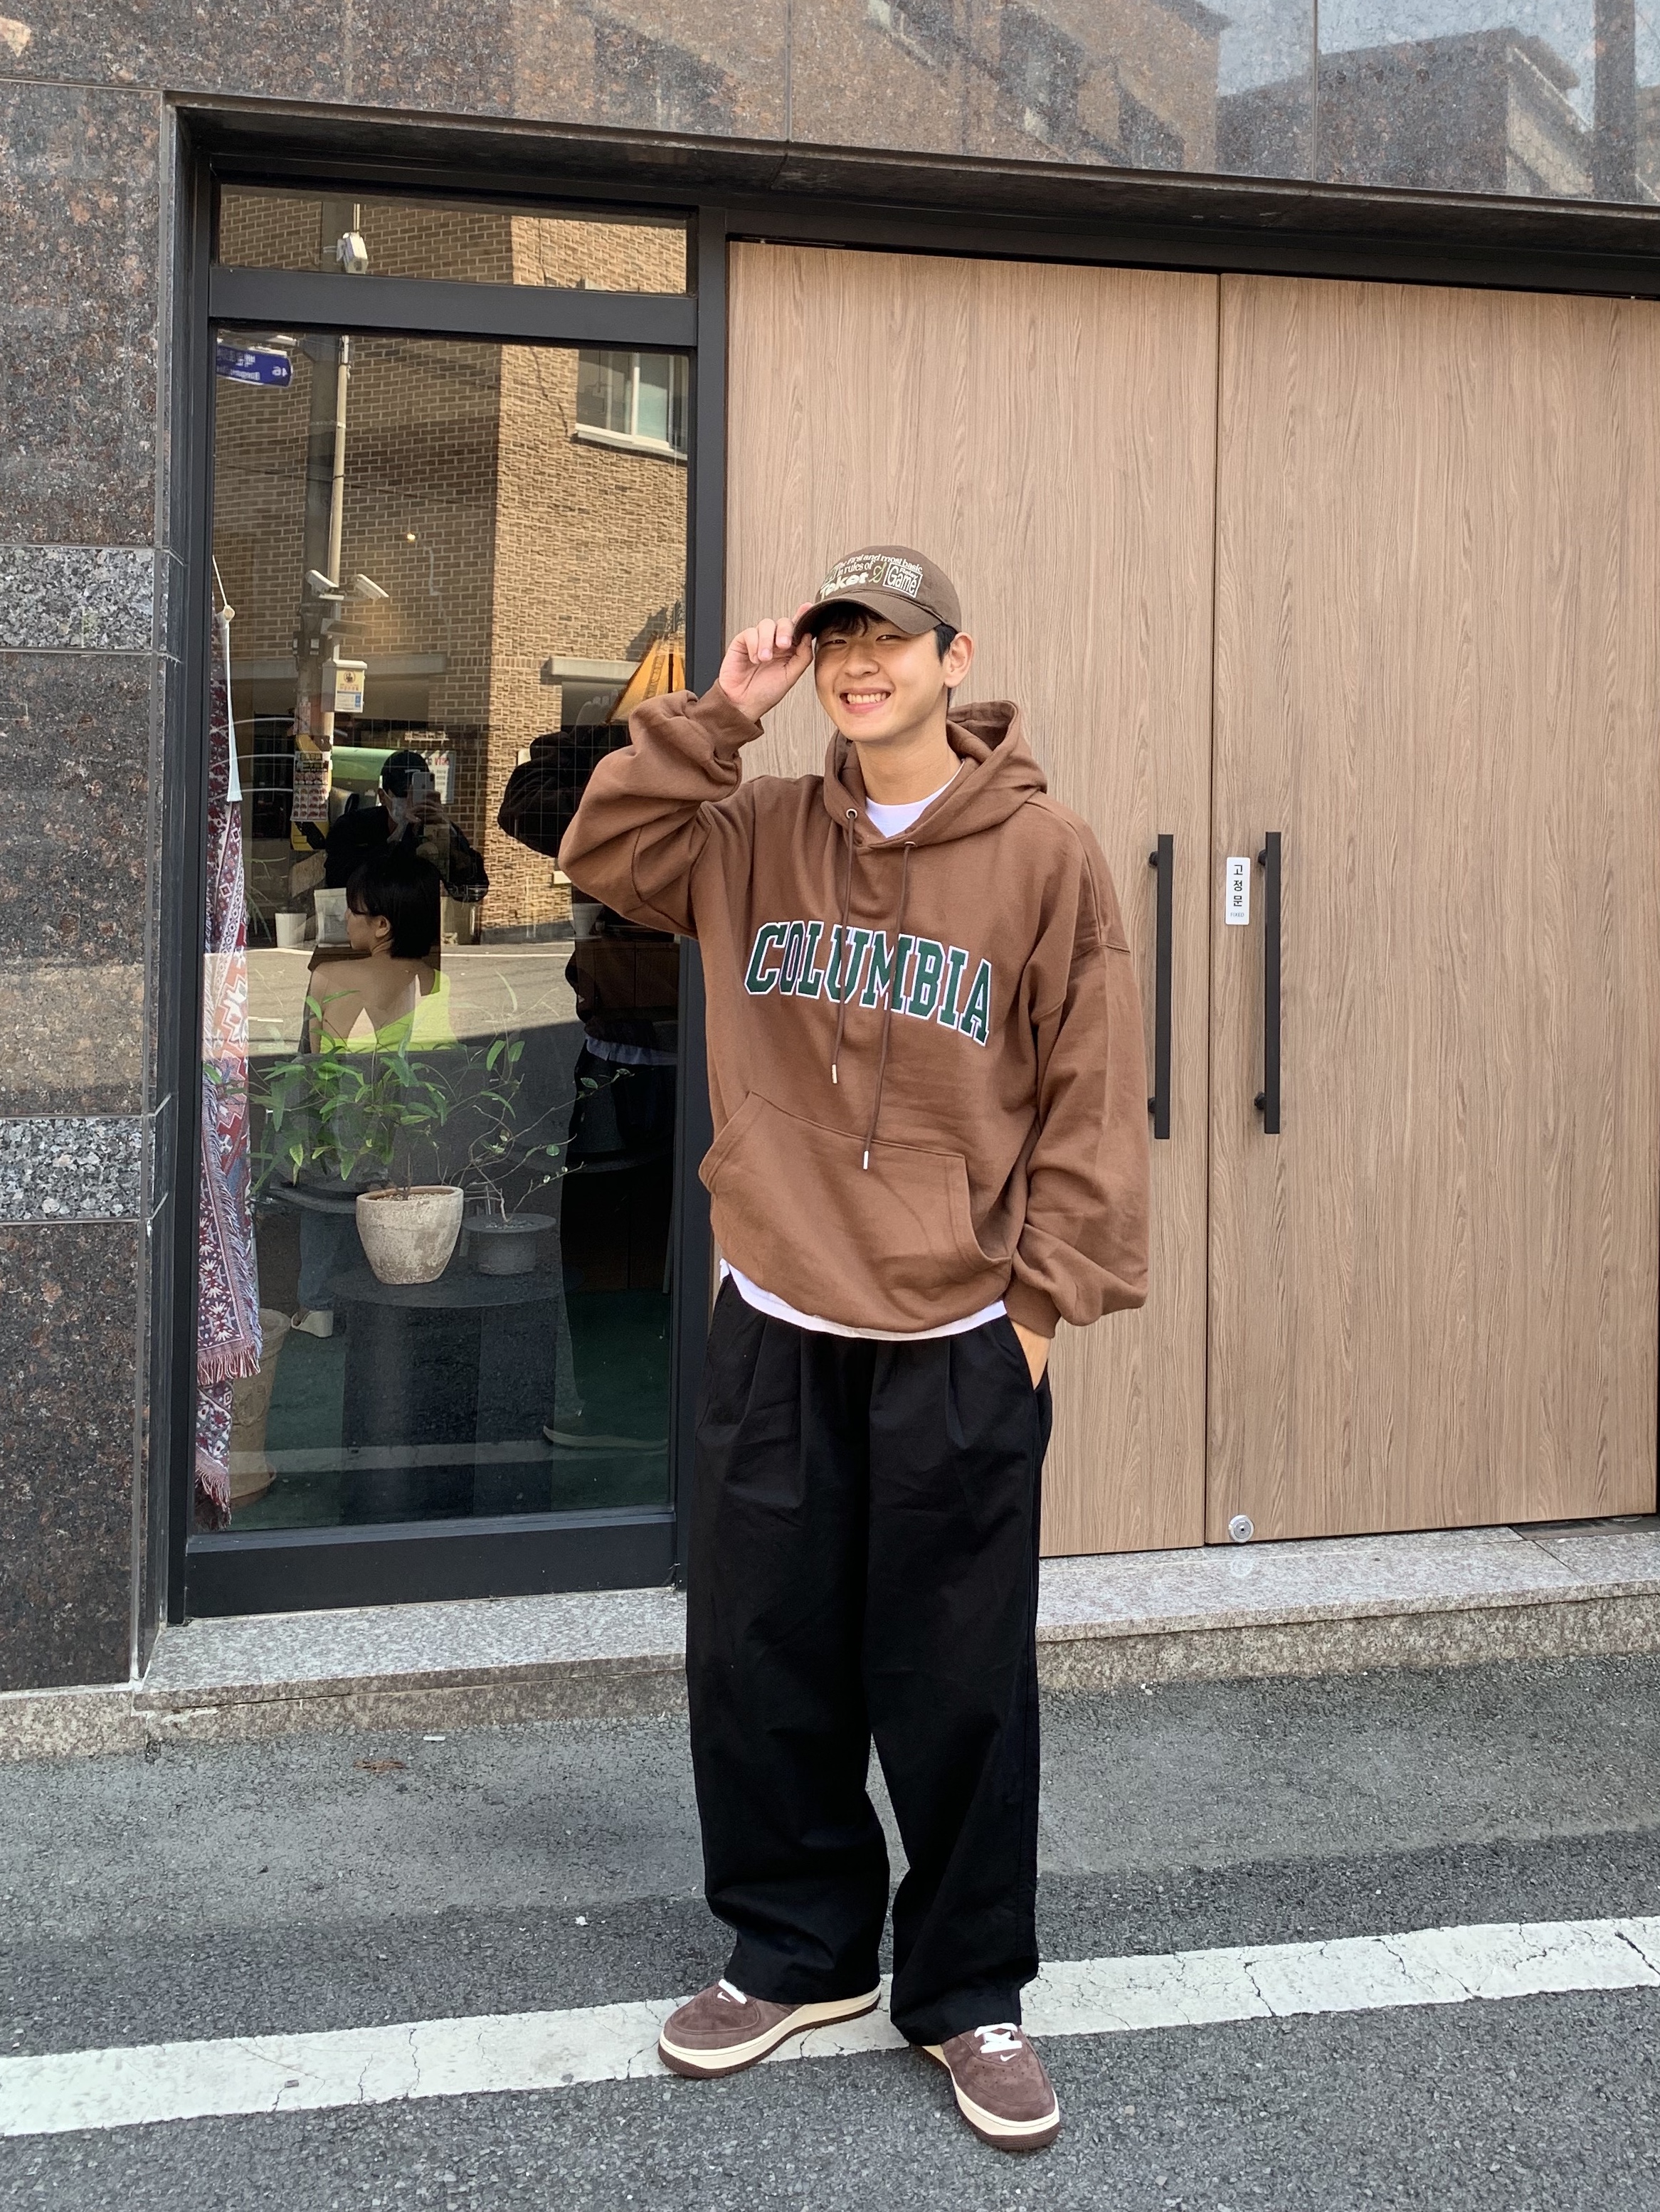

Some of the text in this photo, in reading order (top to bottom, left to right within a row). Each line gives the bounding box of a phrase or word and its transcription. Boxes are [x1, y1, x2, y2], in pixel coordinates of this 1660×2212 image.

[844, 562, 864, 573] rules
[864, 560, 876, 570] of
[881, 556, 902, 565] most
[902, 559, 923, 573] basic
[887, 566, 916, 593] Game
[1233, 864, 1243, 907] 고정문
[744, 921, 992, 1047] COLUMBIA
